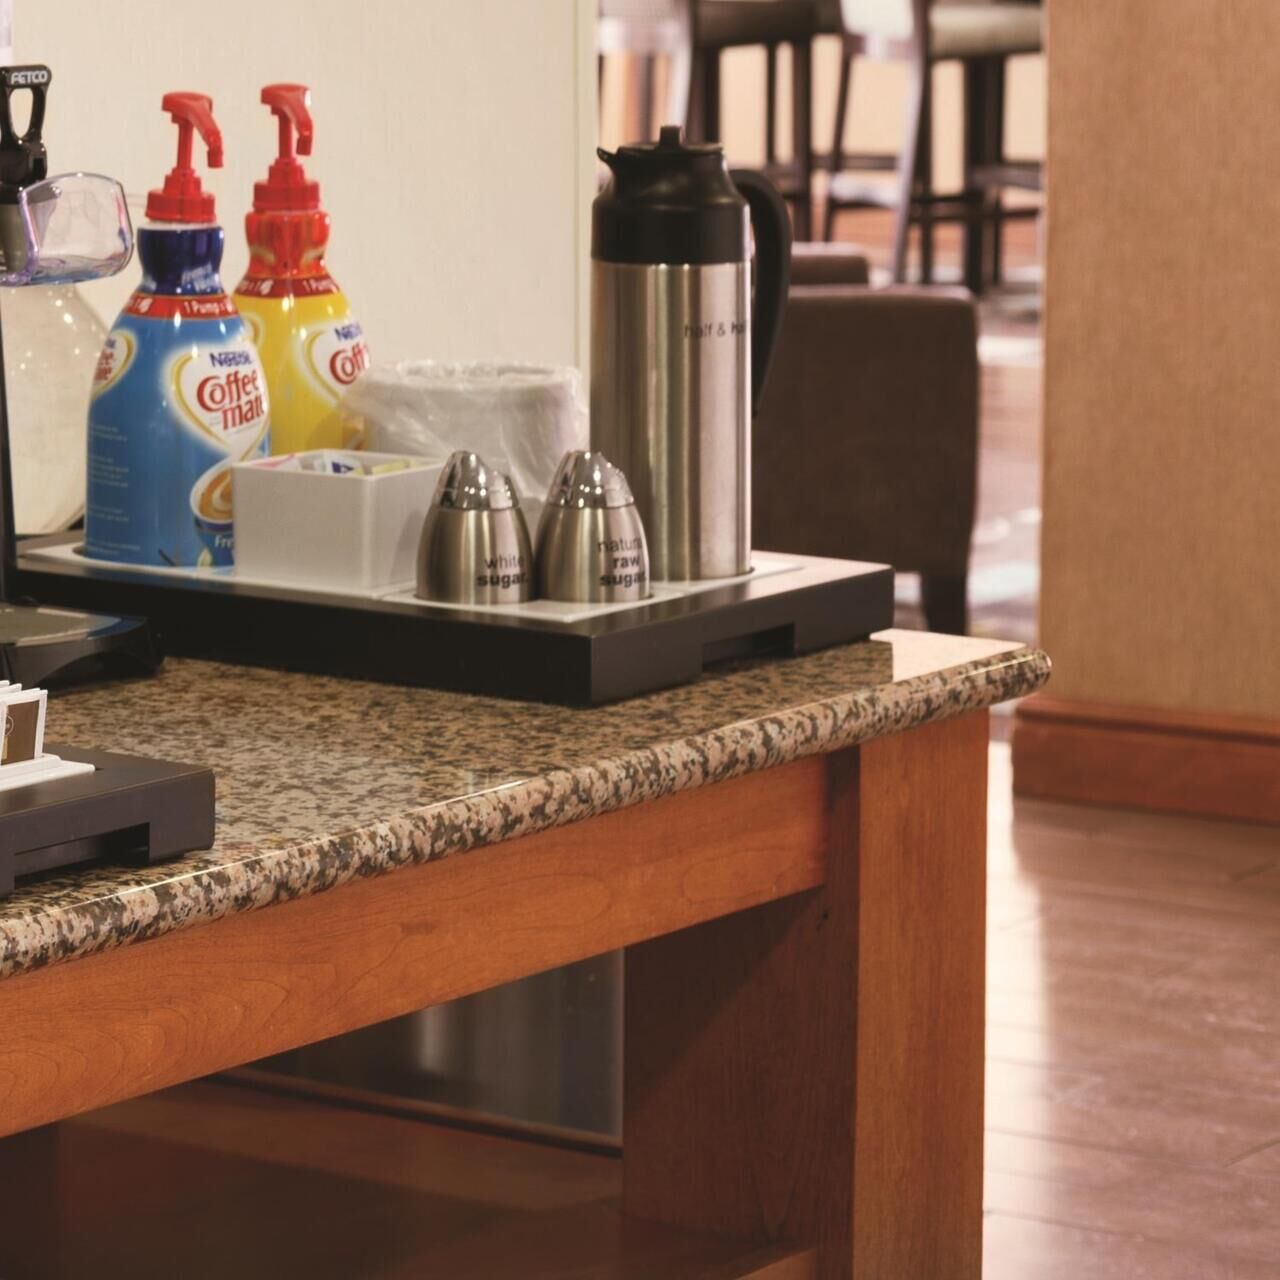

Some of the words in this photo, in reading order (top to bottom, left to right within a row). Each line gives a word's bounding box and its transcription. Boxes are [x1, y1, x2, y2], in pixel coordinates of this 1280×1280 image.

[10, 70, 49, 85] FETCO
[196, 368, 259, 413] Coffee
[484, 554, 526, 569] white
[613, 556, 640, 569] raw
